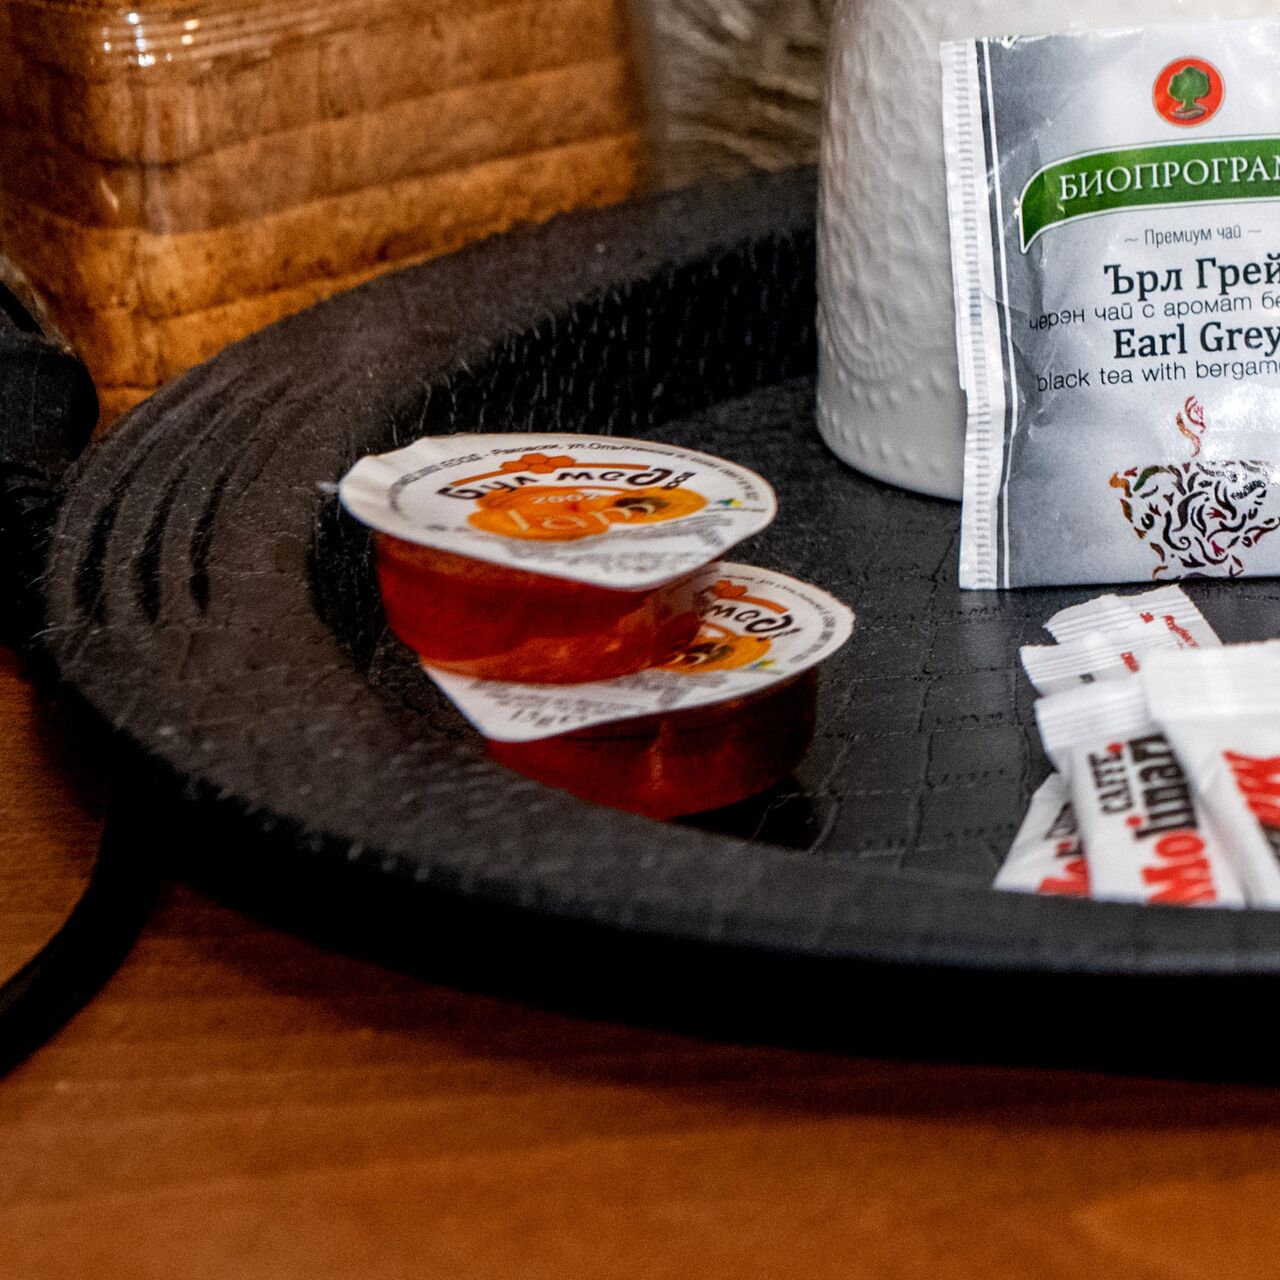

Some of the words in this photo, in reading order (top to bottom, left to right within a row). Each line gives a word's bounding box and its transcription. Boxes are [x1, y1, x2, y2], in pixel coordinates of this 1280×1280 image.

[1144, 225, 1213, 248] Премиум
[1216, 223, 1243, 241] чай
[1104, 262, 1183, 301] Ърл
[1094, 299, 1133, 322] чай
[1142, 303, 1156, 318] с
[1163, 294, 1253, 319] аромат
[1113, 324, 1188, 360] Earl
[1037, 367, 1091, 392] black
[1099, 366, 1133, 386] tea
[1141, 360, 1187, 382] with
